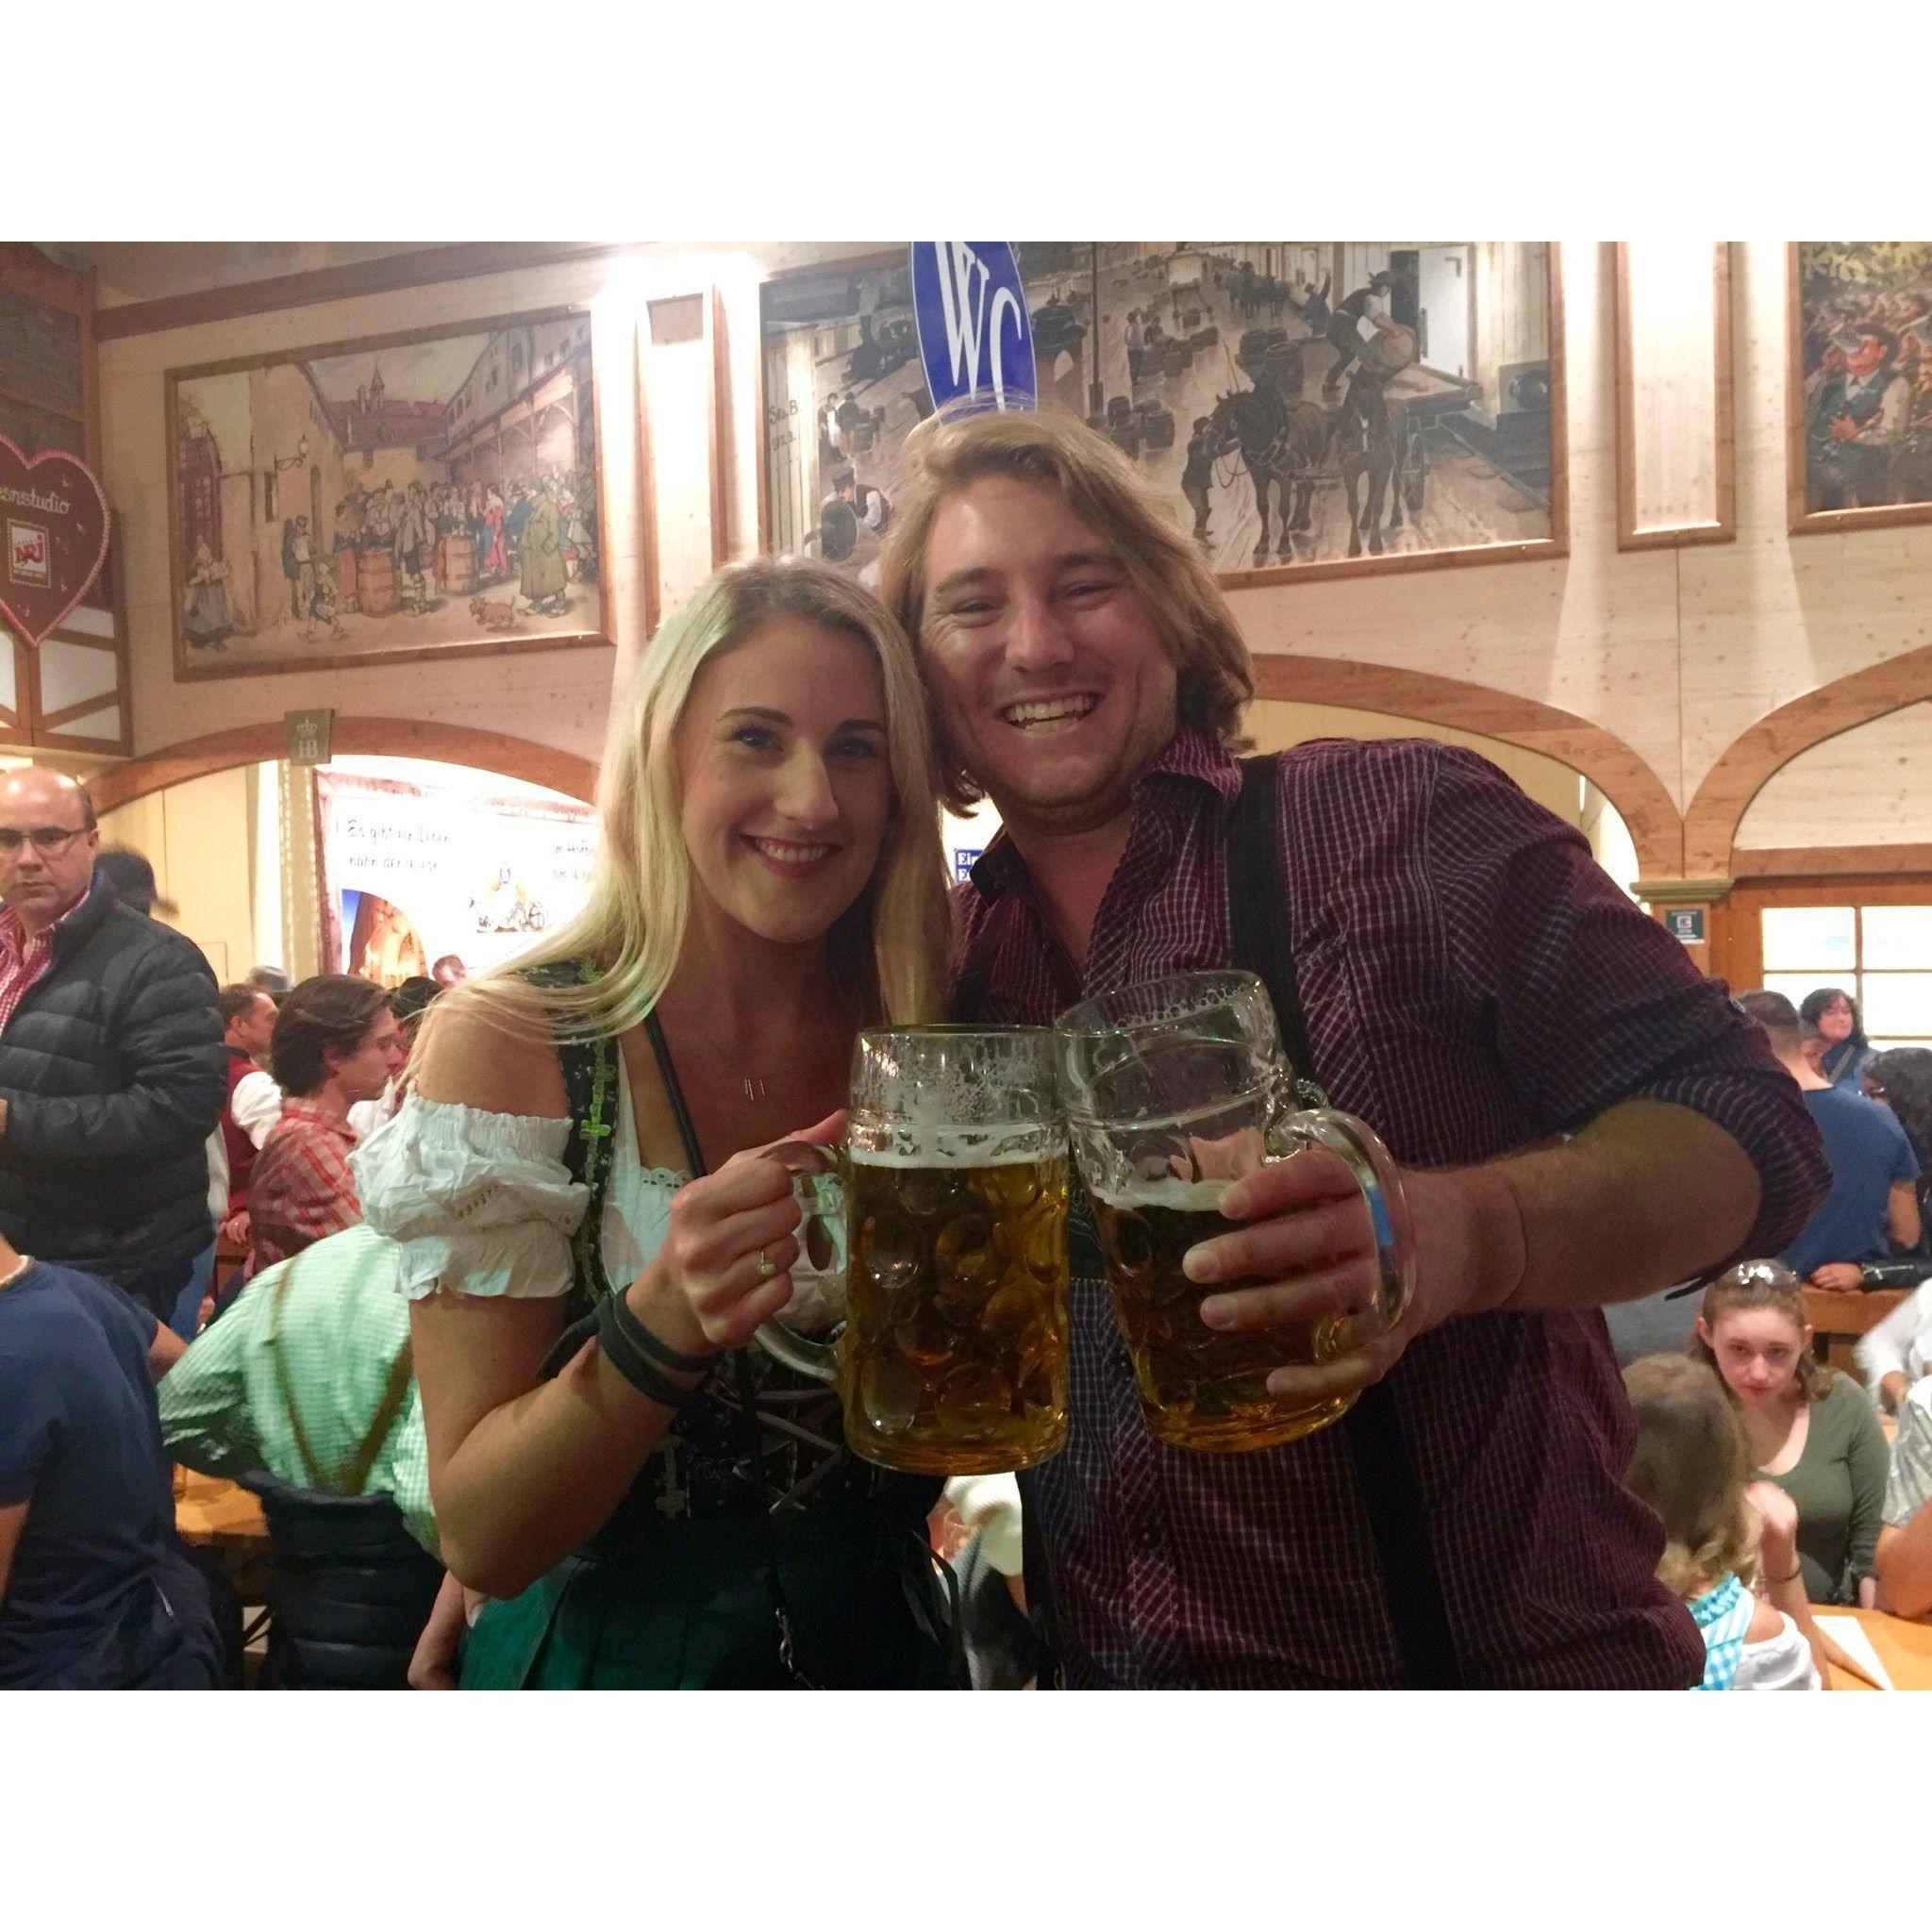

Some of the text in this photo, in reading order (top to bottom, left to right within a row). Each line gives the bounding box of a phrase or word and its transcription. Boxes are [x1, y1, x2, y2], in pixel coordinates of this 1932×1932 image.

[935, 242, 1022, 412] WC
[298, 739, 319, 758] HB
[347, 818, 366, 838] Es
